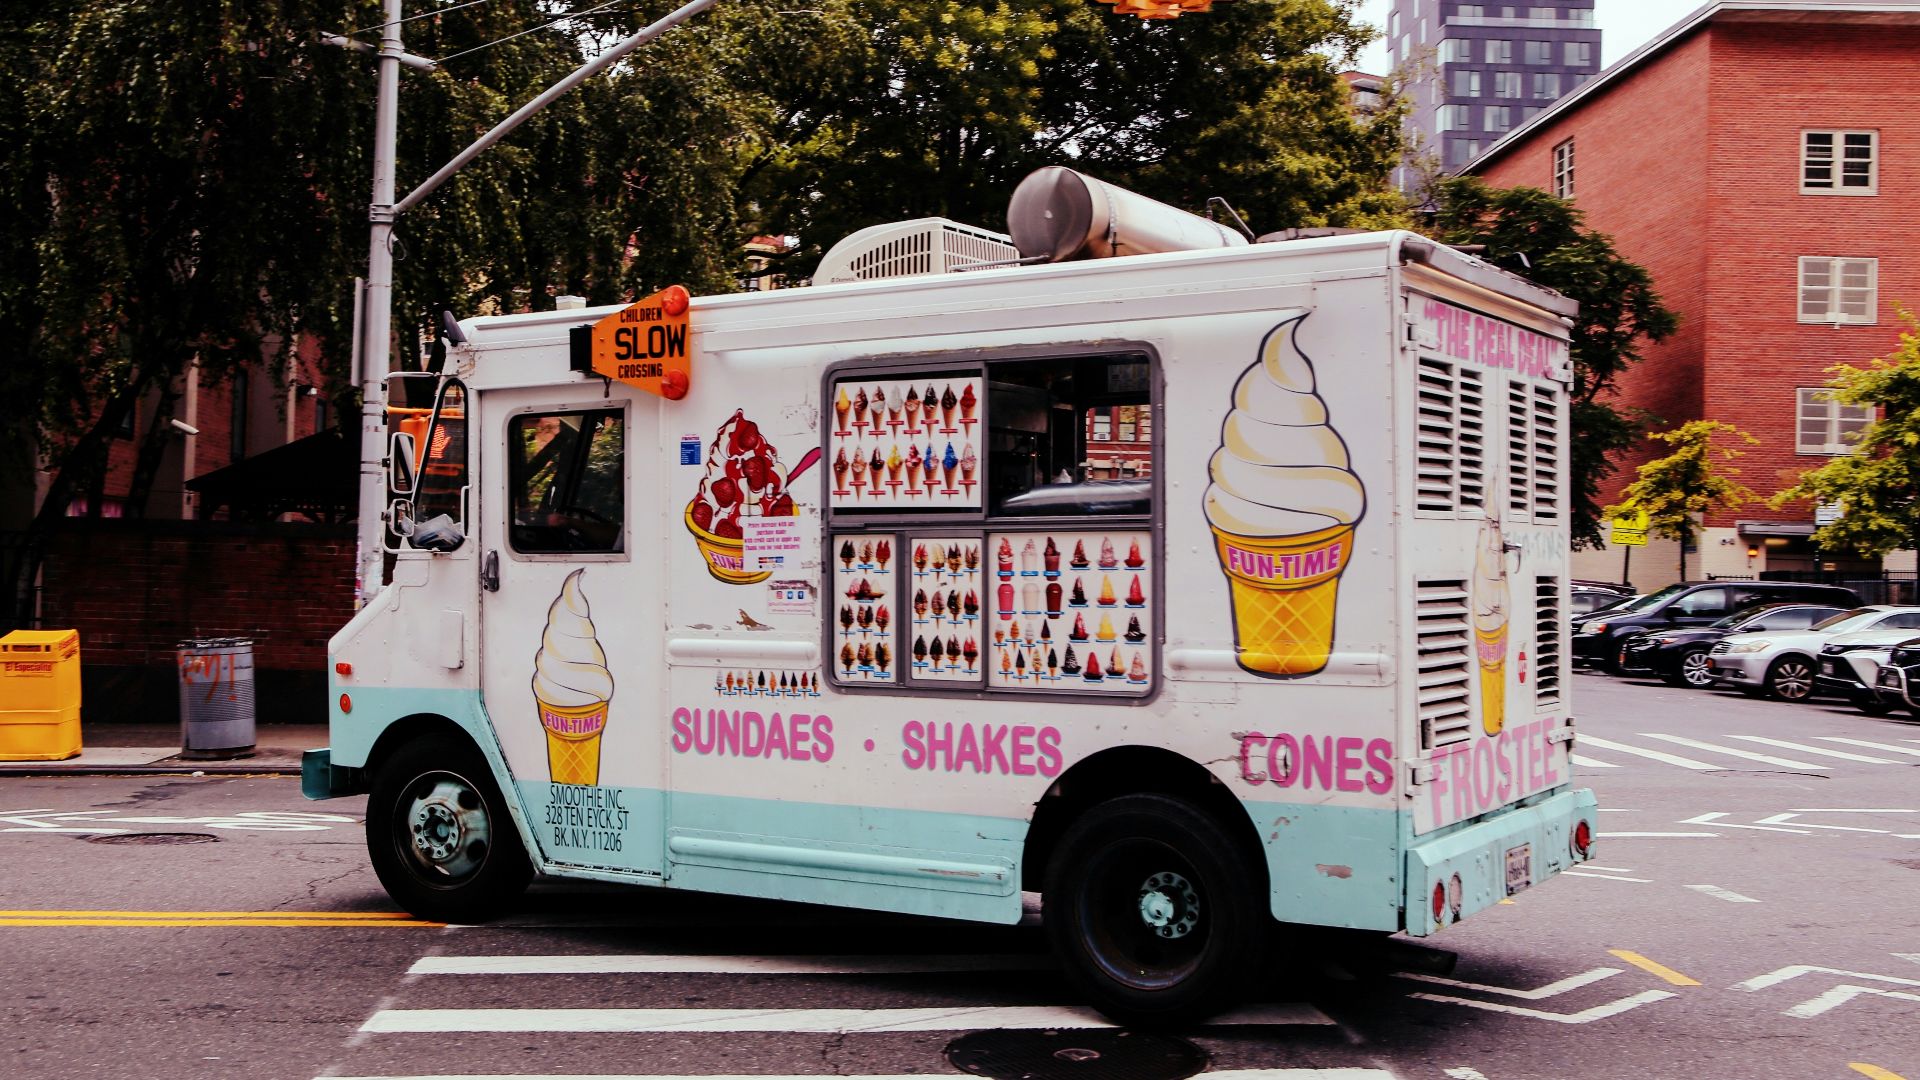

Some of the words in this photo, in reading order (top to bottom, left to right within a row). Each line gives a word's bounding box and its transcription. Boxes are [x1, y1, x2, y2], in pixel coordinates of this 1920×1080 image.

[620, 307, 663, 323] CHILDREN
[614, 323, 687, 361] SLOW
[1474, 316, 1514, 368] REAL
[618, 363, 663, 379] CROSSING
[1225, 542, 1343, 580] FUN-TIME
[544, 711, 603, 734] FUN-TIME
[672, 706, 835, 763] SUNDAES
[902, 720, 1064, 778] SHAKES
[1239, 731, 1394, 795] CONES
[1429, 716, 1558, 827] FROSTEE
[550, 784, 603, 808] SMOOTHIE
[605, 789, 626, 810] INC.
[545, 805, 563, 825] 328
[564, 806, 584, 827] TEN
[587, 808, 615, 830] EYCK.
[617, 810, 630, 831] ST
[554, 827, 570, 848] BK.
[572, 828, 590, 849] N.Y.
[592, 831, 622, 852] 11206
